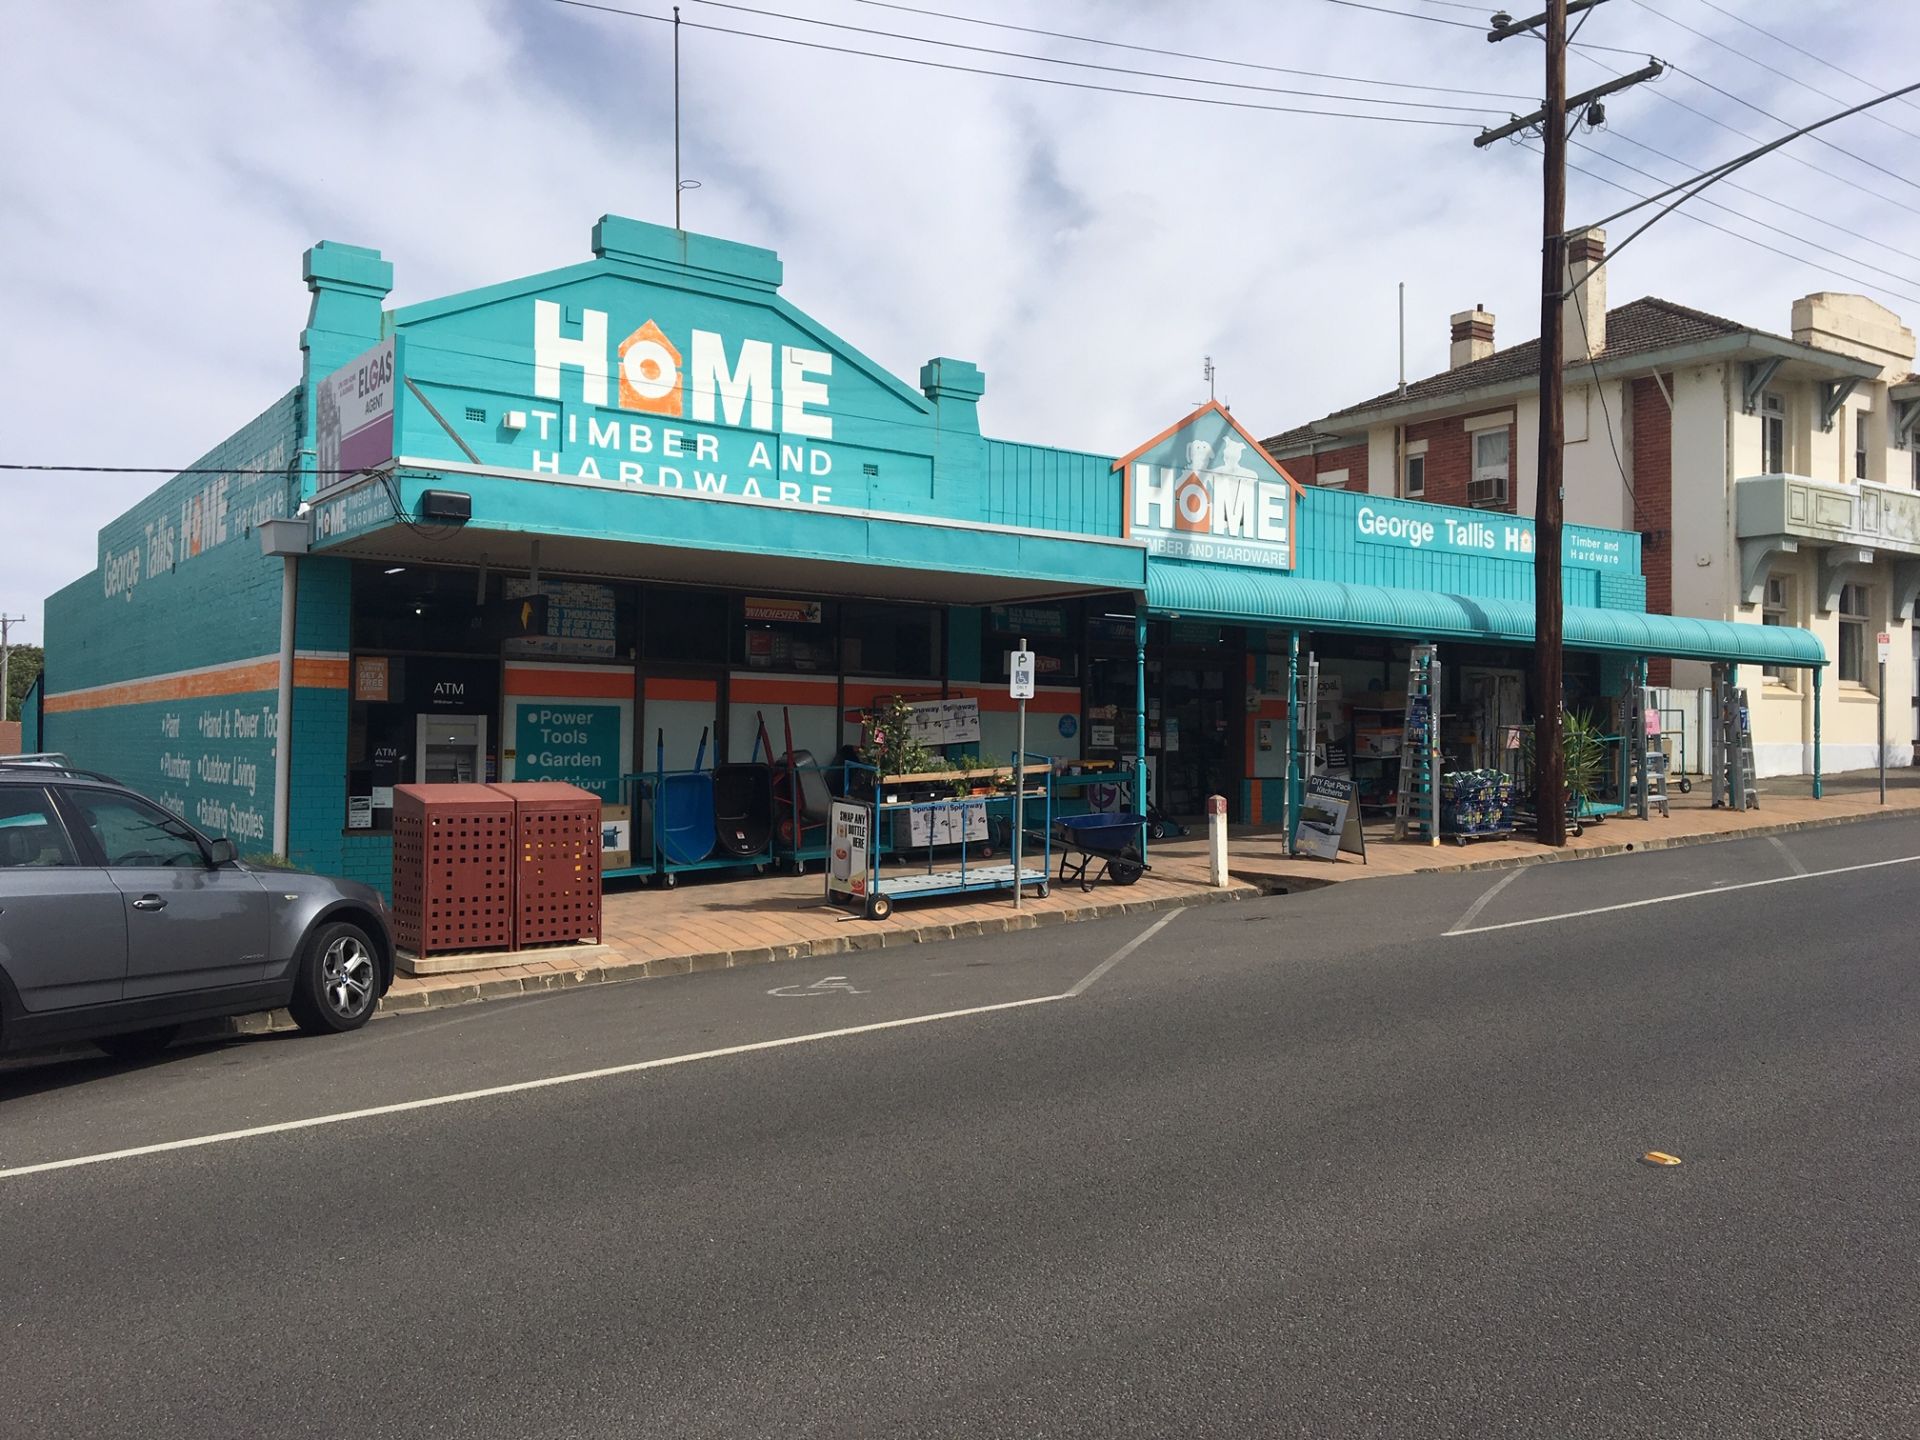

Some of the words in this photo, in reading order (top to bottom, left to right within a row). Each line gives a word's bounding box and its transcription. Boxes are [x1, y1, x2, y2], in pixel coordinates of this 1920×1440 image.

[358, 350, 392, 399] ELGAS
[534, 298, 833, 440] HOME
[365, 393, 384, 415] AGENT
[531, 409, 720, 464] TIMBER
[748, 440, 833, 477] AND
[532, 450, 833, 506] HARDWARE
[1135, 463, 1287, 543] HOME
[315, 499, 348, 541] HOME
[105, 546, 140, 602] George
[145, 514, 175, 580] Tallis
[180, 474, 228, 563] HOME
[1357, 507, 1434, 547] George
[1444, 518, 1496, 550] Tallis
[1504, 526, 1536, 554] HO
[1570, 534, 1601, 549] Timber
[1603, 540, 1619, 552] and
[1186, 542, 1214, 559] AND
[1216, 545, 1288, 567] HARDWARE
[1570, 549, 1619, 565] Hardware
[745, 607, 800, 620] WINCHESTER
[1018, 655, 1028, 668] P
[433, 682, 465, 696] ATM
[203, 708, 223, 738] Hand
[234, 708, 259, 738] Power
[263, 706, 279, 738] Too
[540, 710, 595, 725] Power
[540, 728, 588, 744] Tools
[375, 747, 397, 758] ATM
[540, 751, 602, 767] Garden
[202, 753, 231, 785] Outdoor
[232, 755, 256, 797] Living
[1311, 777, 1324, 786] DIY
[1323, 779, 1336, 788] Flat
[1336, 782, 1352, 792] Pack
[1316, 785, 1344, 797] Kitchens
[201, 797, 228, 839] Building
[230, 801, 264, 843] Supplies
[839, 810, 854, 822] SWAP
[854, 812, 866, 825] ANY
[847, 823, 866, 837] BOTTLE
[852, 836, 865, 849] HERE
